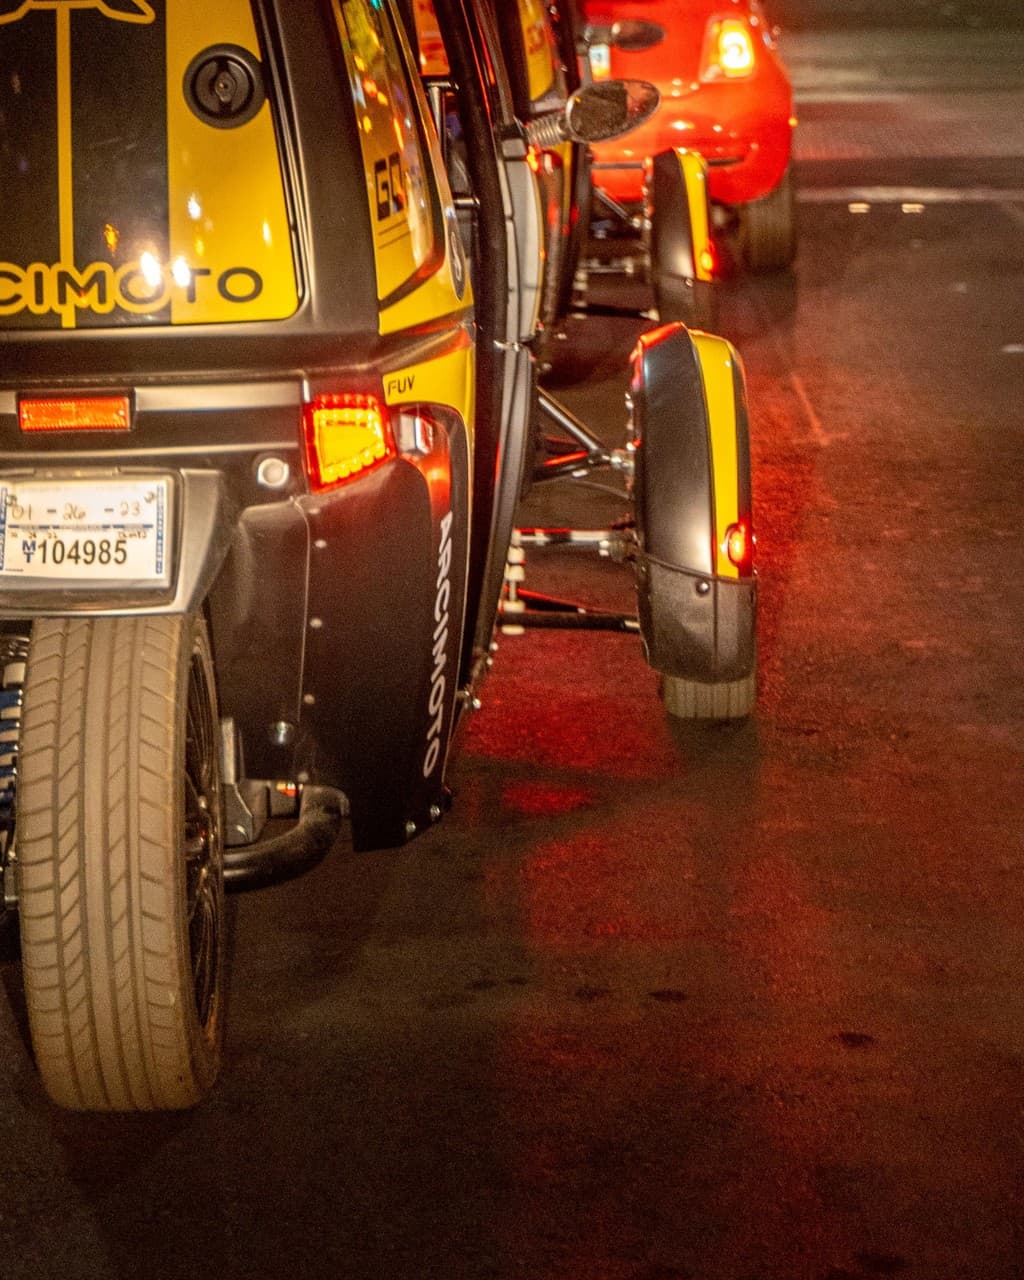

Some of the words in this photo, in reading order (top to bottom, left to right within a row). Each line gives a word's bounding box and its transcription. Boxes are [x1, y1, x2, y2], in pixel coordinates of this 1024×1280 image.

[387, 374, 416, 397] FUV
[37, 538, 128, 566] 104985
[422, 510, 454, 780] ARCIMOTO
